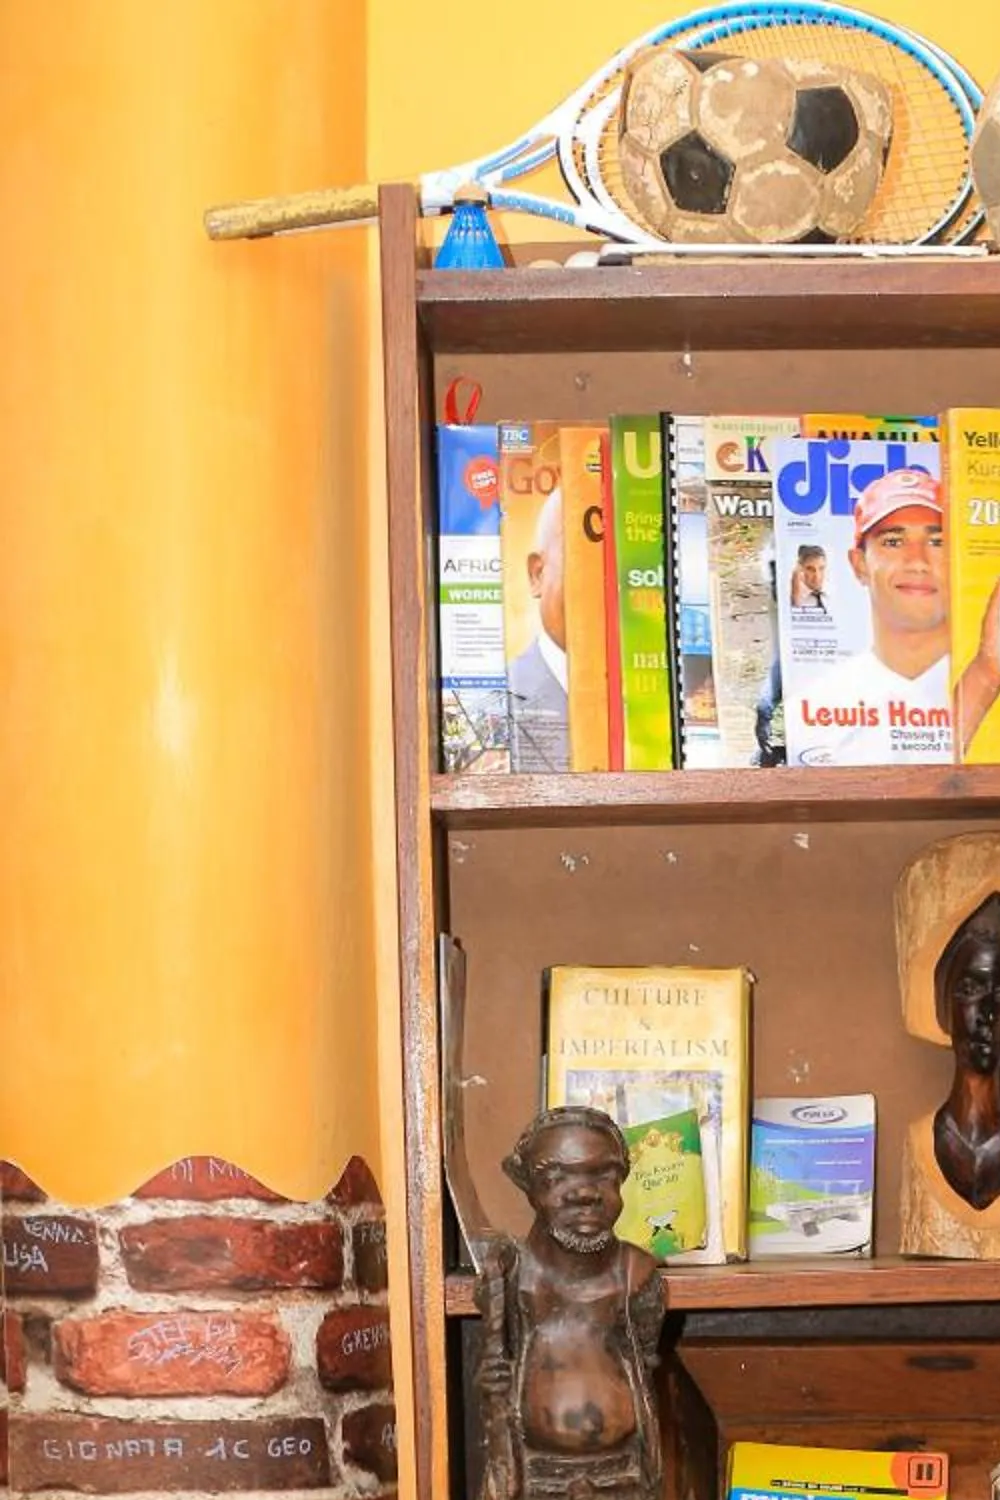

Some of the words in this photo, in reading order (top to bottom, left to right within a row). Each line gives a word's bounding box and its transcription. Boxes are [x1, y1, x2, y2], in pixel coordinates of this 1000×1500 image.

[801, 700, 879, 727] Lewis
[888, 701, 950, 727] Ham
[584, 987, 706, 1006] CULTURE
[559, 1038, 730, 1057] IMPERIALISM
